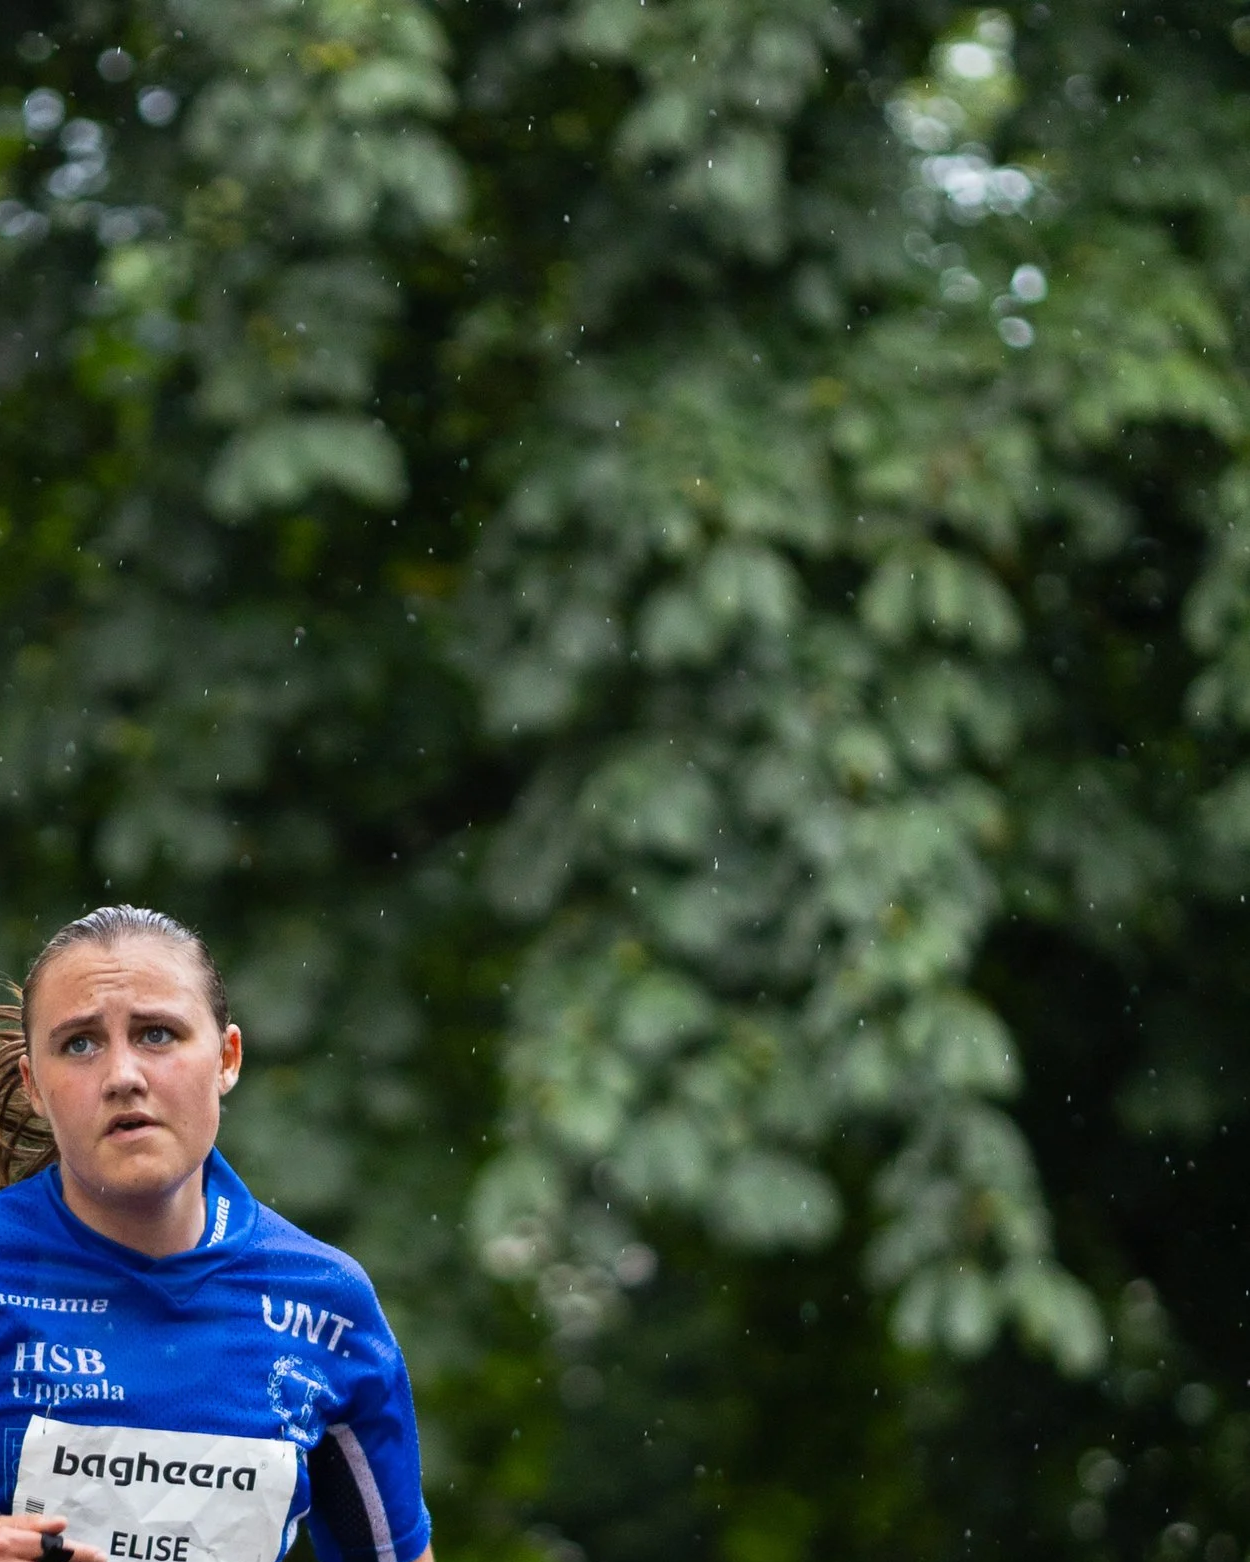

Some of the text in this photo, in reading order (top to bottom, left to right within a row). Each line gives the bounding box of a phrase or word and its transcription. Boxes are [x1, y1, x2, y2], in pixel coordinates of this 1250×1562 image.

[207, 1195, 230, 1247] name
[261, 1294, 354, 1358] UNT.
[13, 1342, 106, 1374] HSB
[12, 1377, 126, 1405] Uppsala
[52, 1444, 257, 1491] bagheera
[110, 1530, 190, 1562] ELISE
